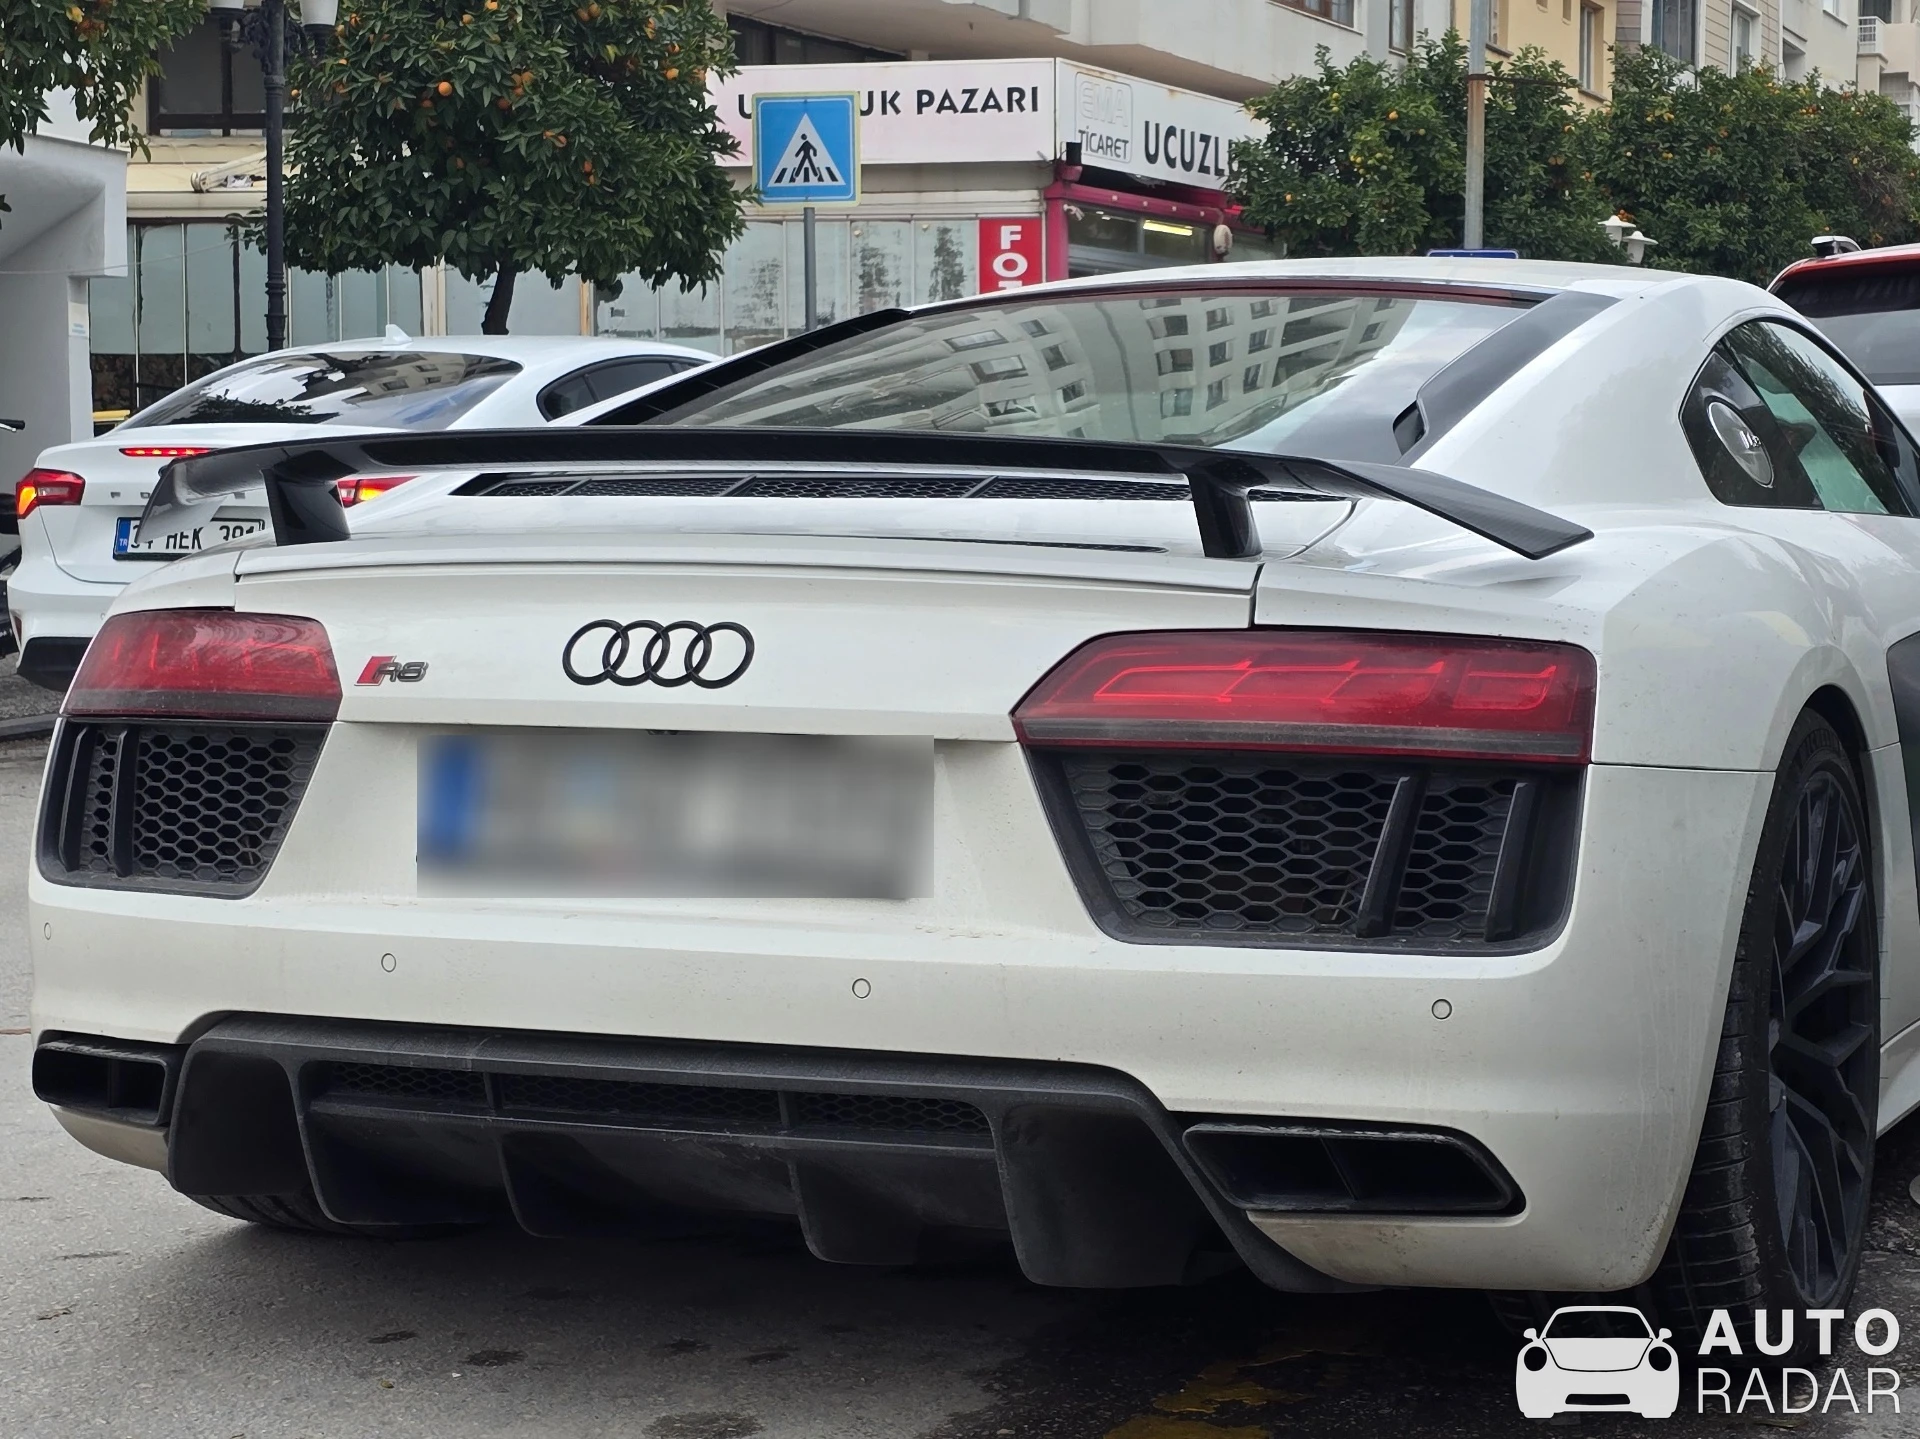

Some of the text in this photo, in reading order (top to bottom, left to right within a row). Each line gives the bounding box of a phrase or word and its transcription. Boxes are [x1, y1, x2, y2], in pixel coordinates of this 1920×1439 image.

[916, 86, 1039, 115] PAZARI
[1078, 125, 1129, 160] TİCARET
[1144, 120, 1238, 178] UCUZL
[119, 538, 128, 547] TR
[369, 660, 430, 683] R8
